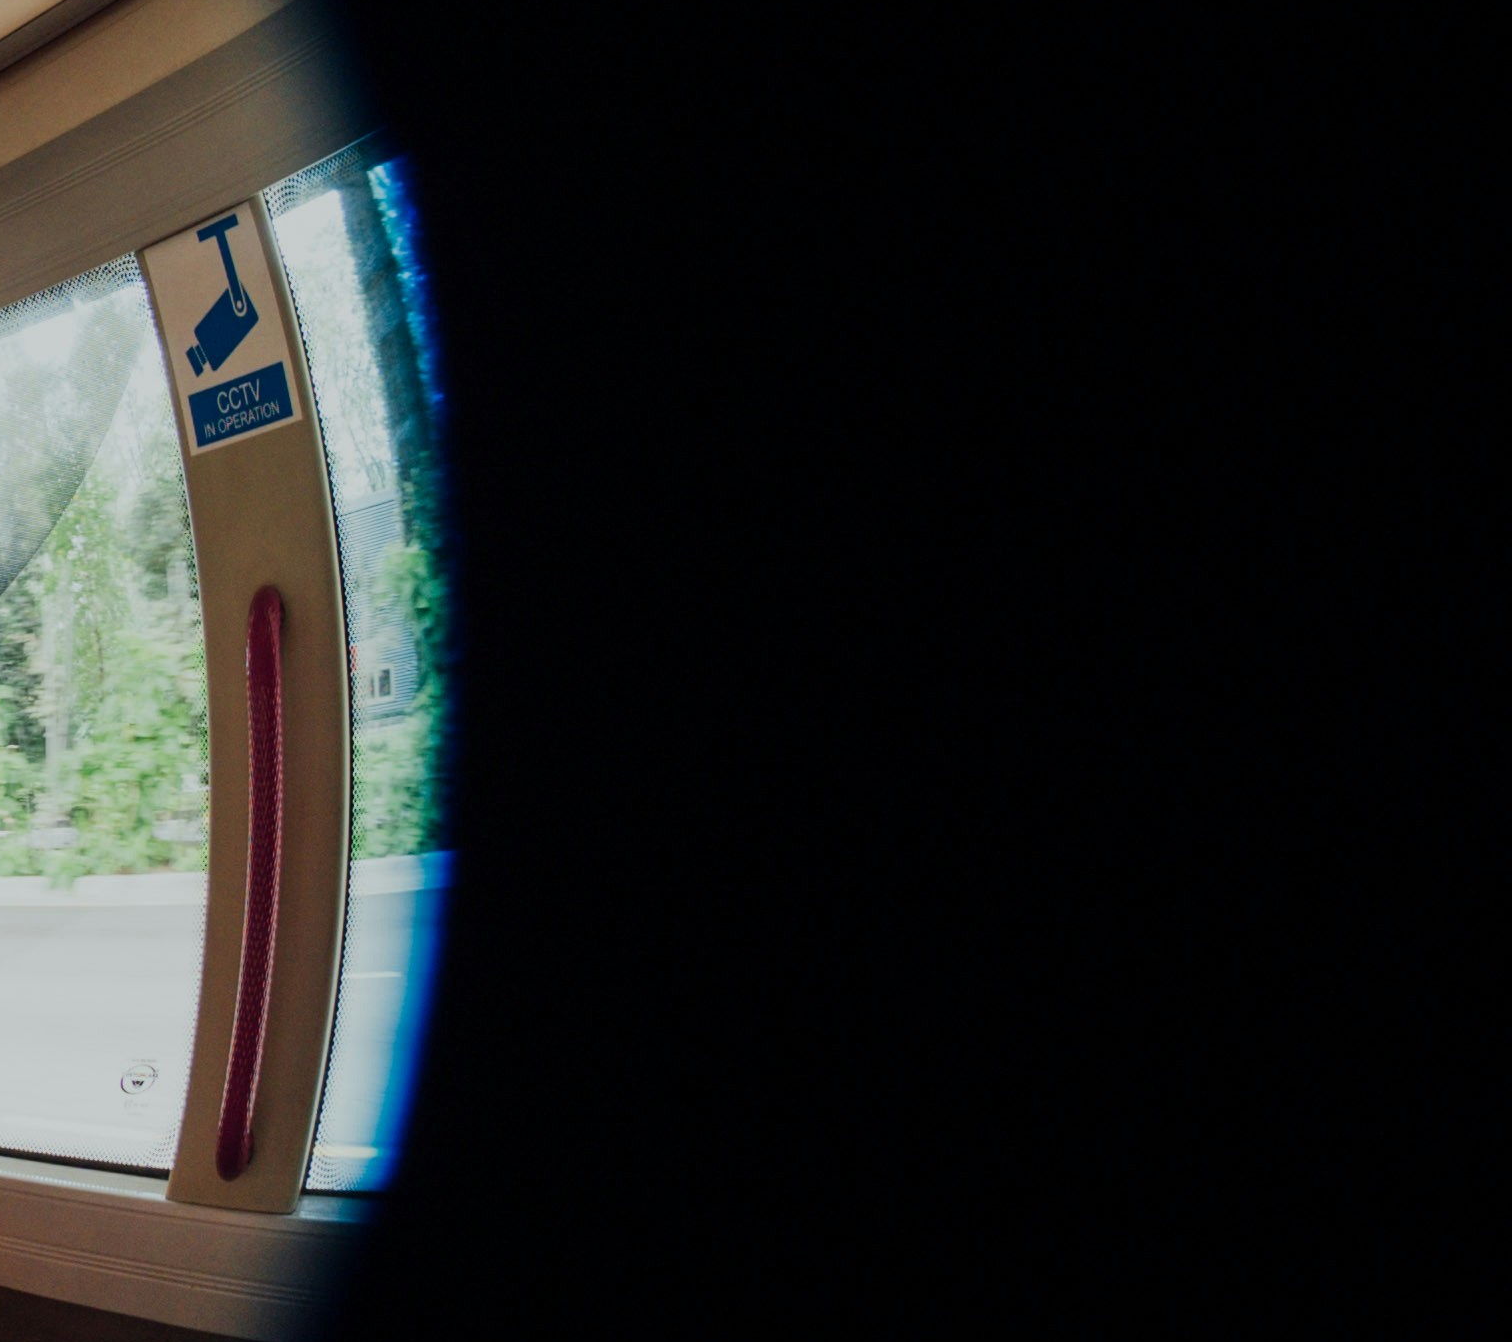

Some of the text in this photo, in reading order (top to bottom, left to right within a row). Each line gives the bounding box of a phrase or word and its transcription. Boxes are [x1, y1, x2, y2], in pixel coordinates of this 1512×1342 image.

[216, 378, 260, 414] CCTV
[204, 399, 280, 438] IN OPERATION
